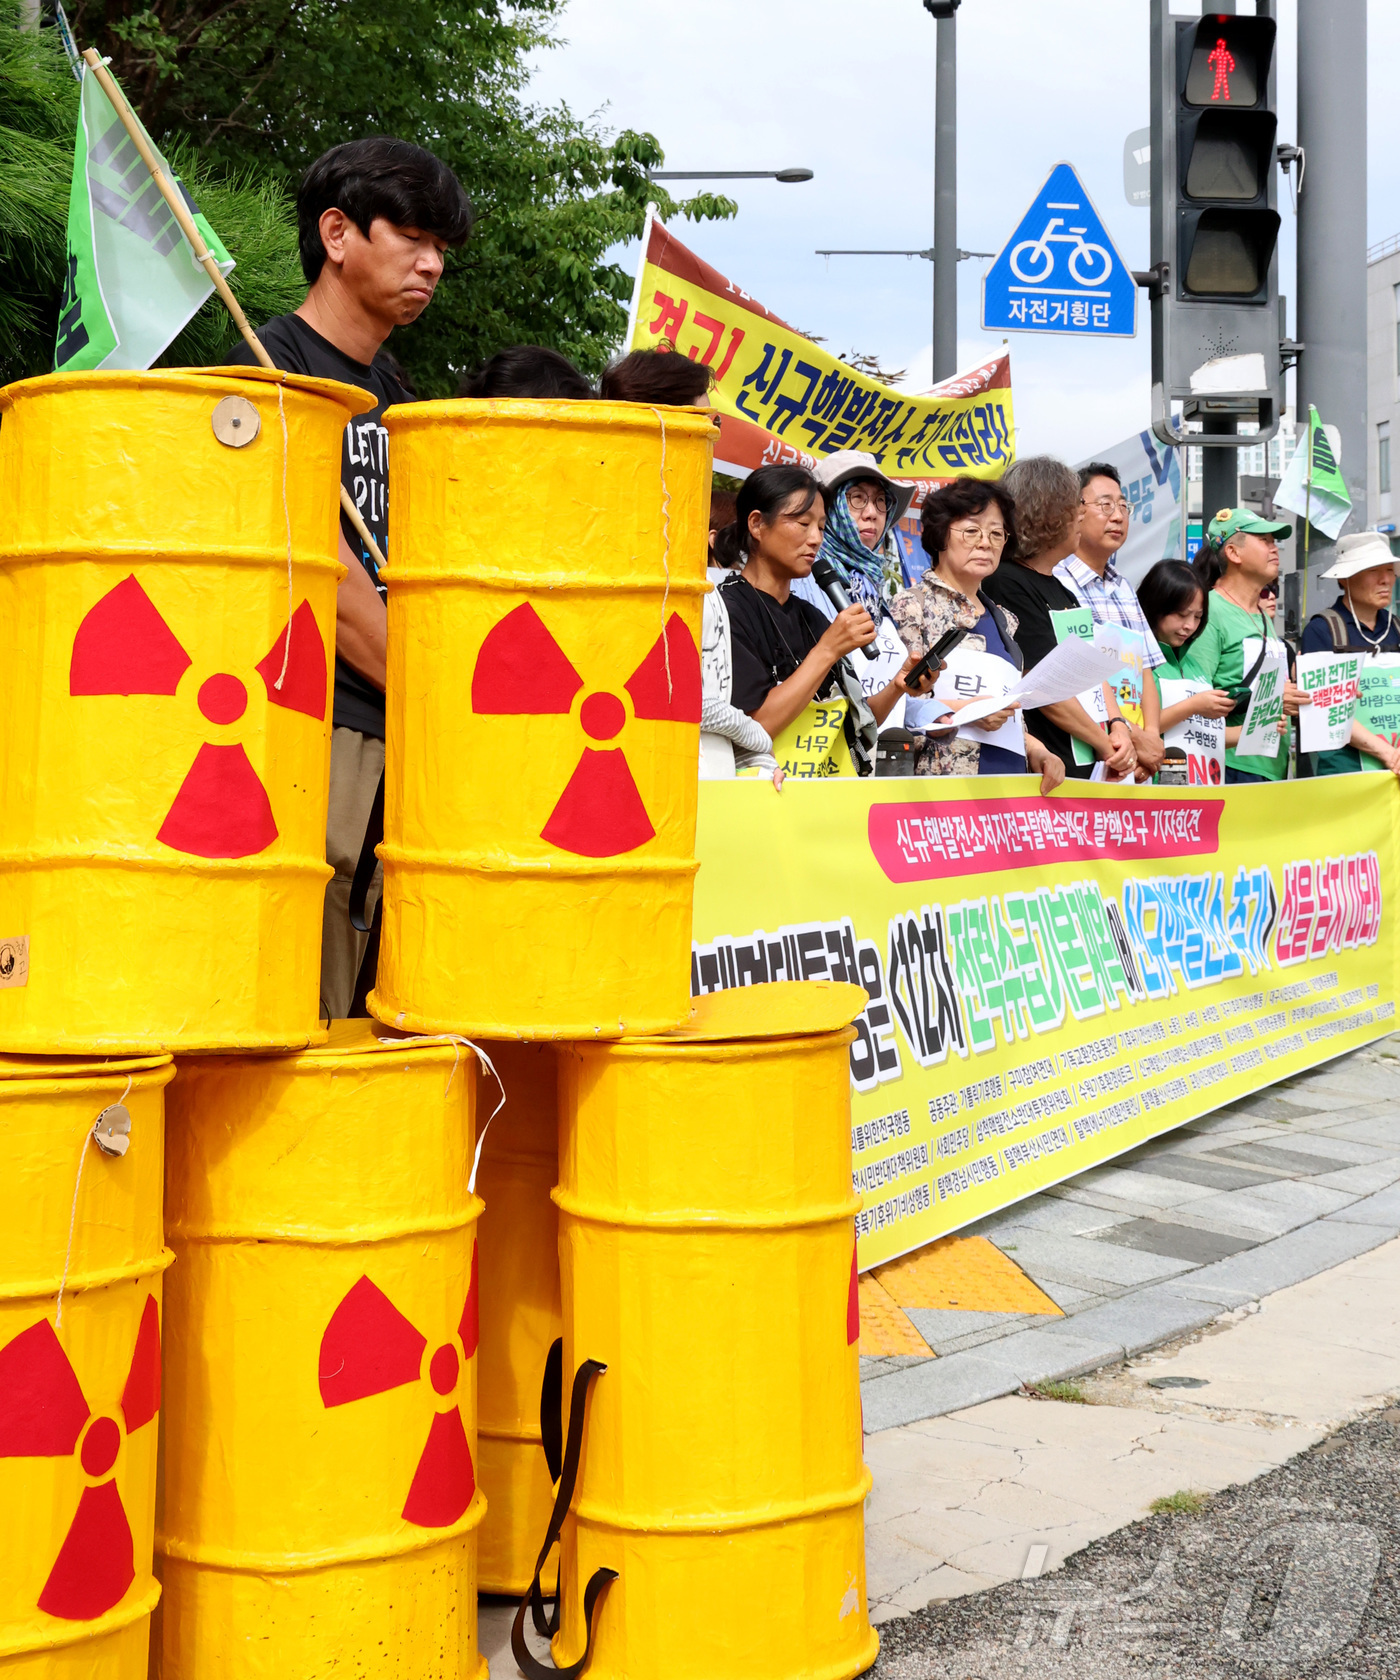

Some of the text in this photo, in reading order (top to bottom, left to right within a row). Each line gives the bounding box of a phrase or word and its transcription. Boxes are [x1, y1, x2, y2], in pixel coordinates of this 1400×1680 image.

[1008, 298, 1111, 328] 자전거횡단
[1301, 658, 1358, 691] 12차 전기본
[1360, 677, 1390, 692] 빛으로
[796, 735, 829, 753] 너무
[1183, 729, 1218, 749] 수명연장
[1093, 810, 1149, 848] 탈핵요구
[1151, 808, 1203, 842] 기자회견
[1124, 876, 1242, 993] 신규핵발전소
[1277, 865, 1316, 962] 선을
[1312, 861, 1346, 953] 넘지
[1346, 854, 1381, 945] 마라
[960, 1076, 1003, 1109] 가톨릭기후행동
[1008, 1056, 1055, 1090] 구미참여연대
[936, 1127, 970, 1159] 사회민주당
[975, 1088, 1072, 1142] 삼척핵발전소반대투쟁위원회
[937, 1155, 998, 1200] 탈핵경남시민행동
[1003, 1127, 1068, 1169] 탈핵부산시민연대
